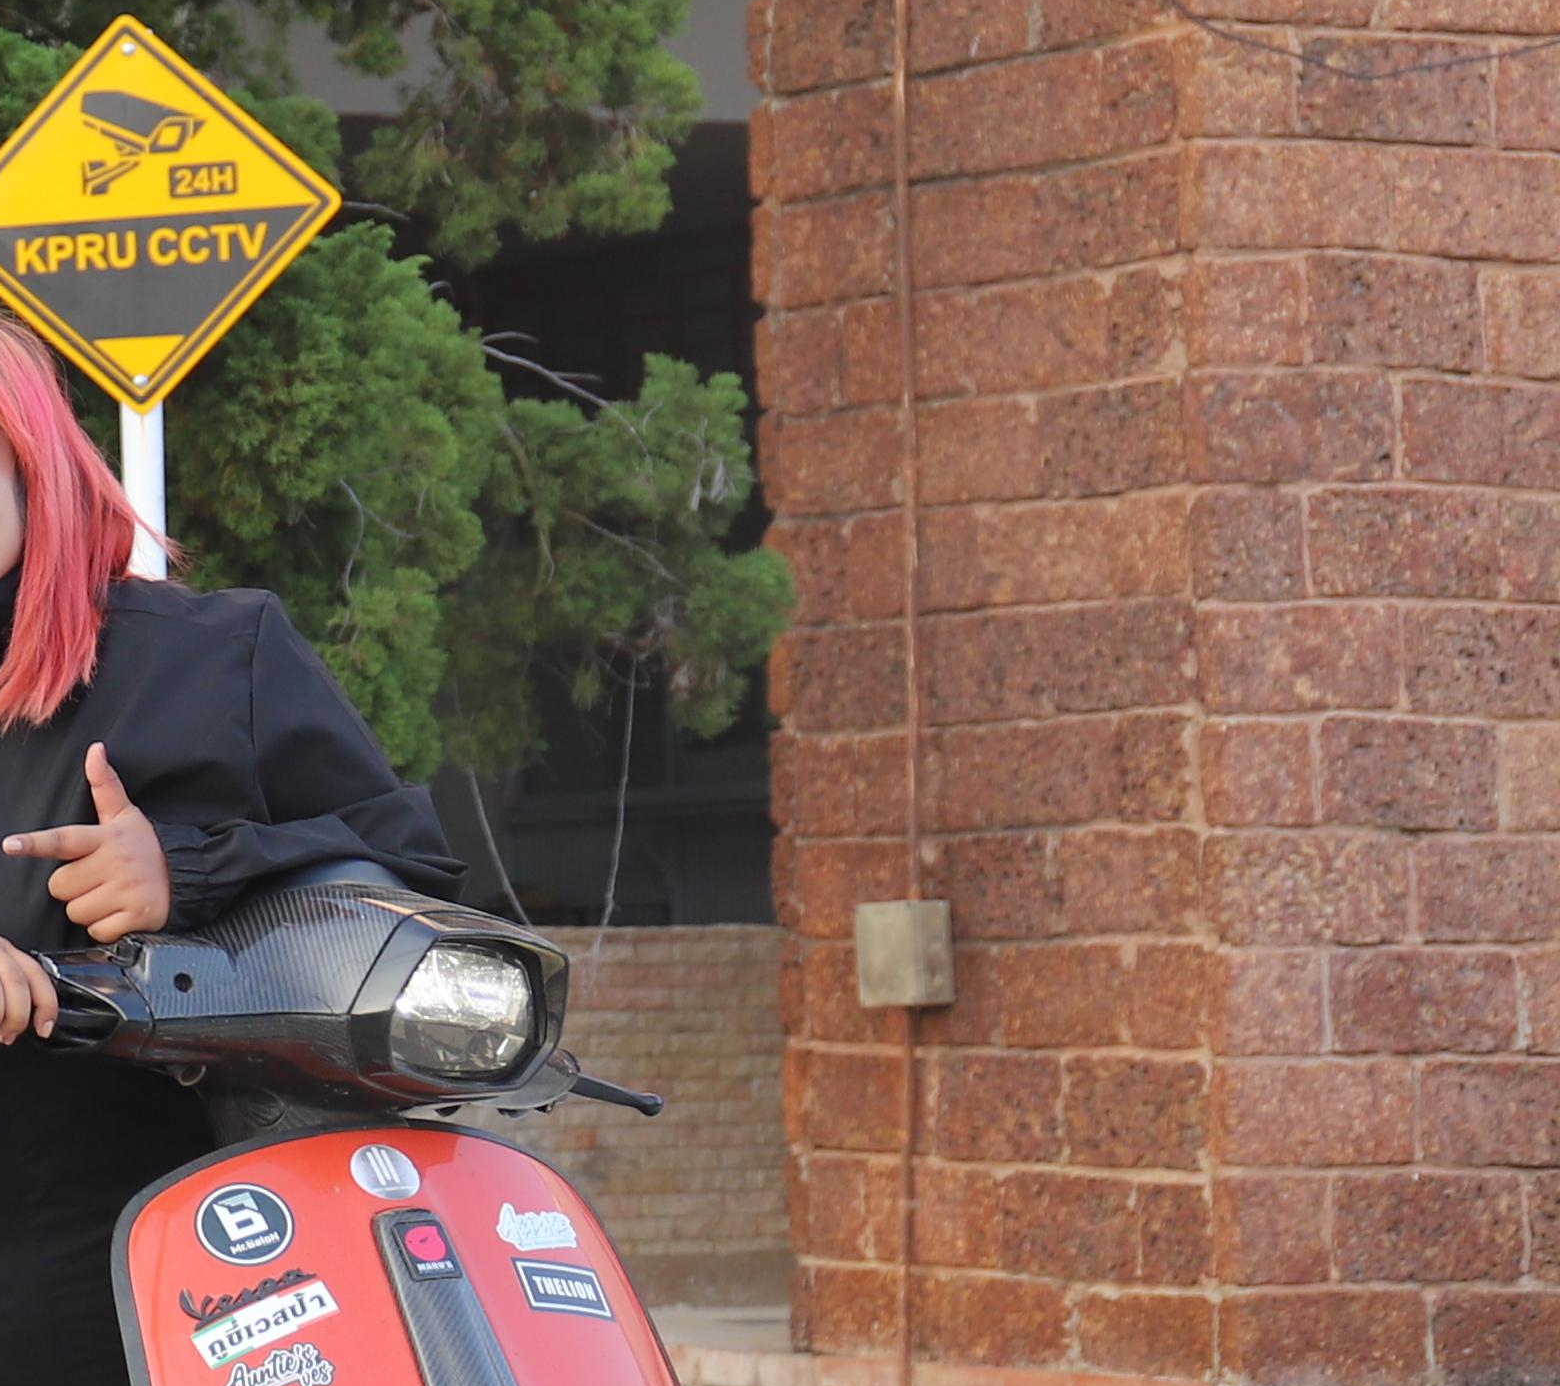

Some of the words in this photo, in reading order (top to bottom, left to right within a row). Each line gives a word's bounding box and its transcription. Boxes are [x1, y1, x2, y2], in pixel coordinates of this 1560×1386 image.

[174, 166, 234, 196] 24H
[14, 231, 137, 276] KPRU
[147, 221, 268, 268] CCTV
[531, 1275, 598, 1302] THELION
